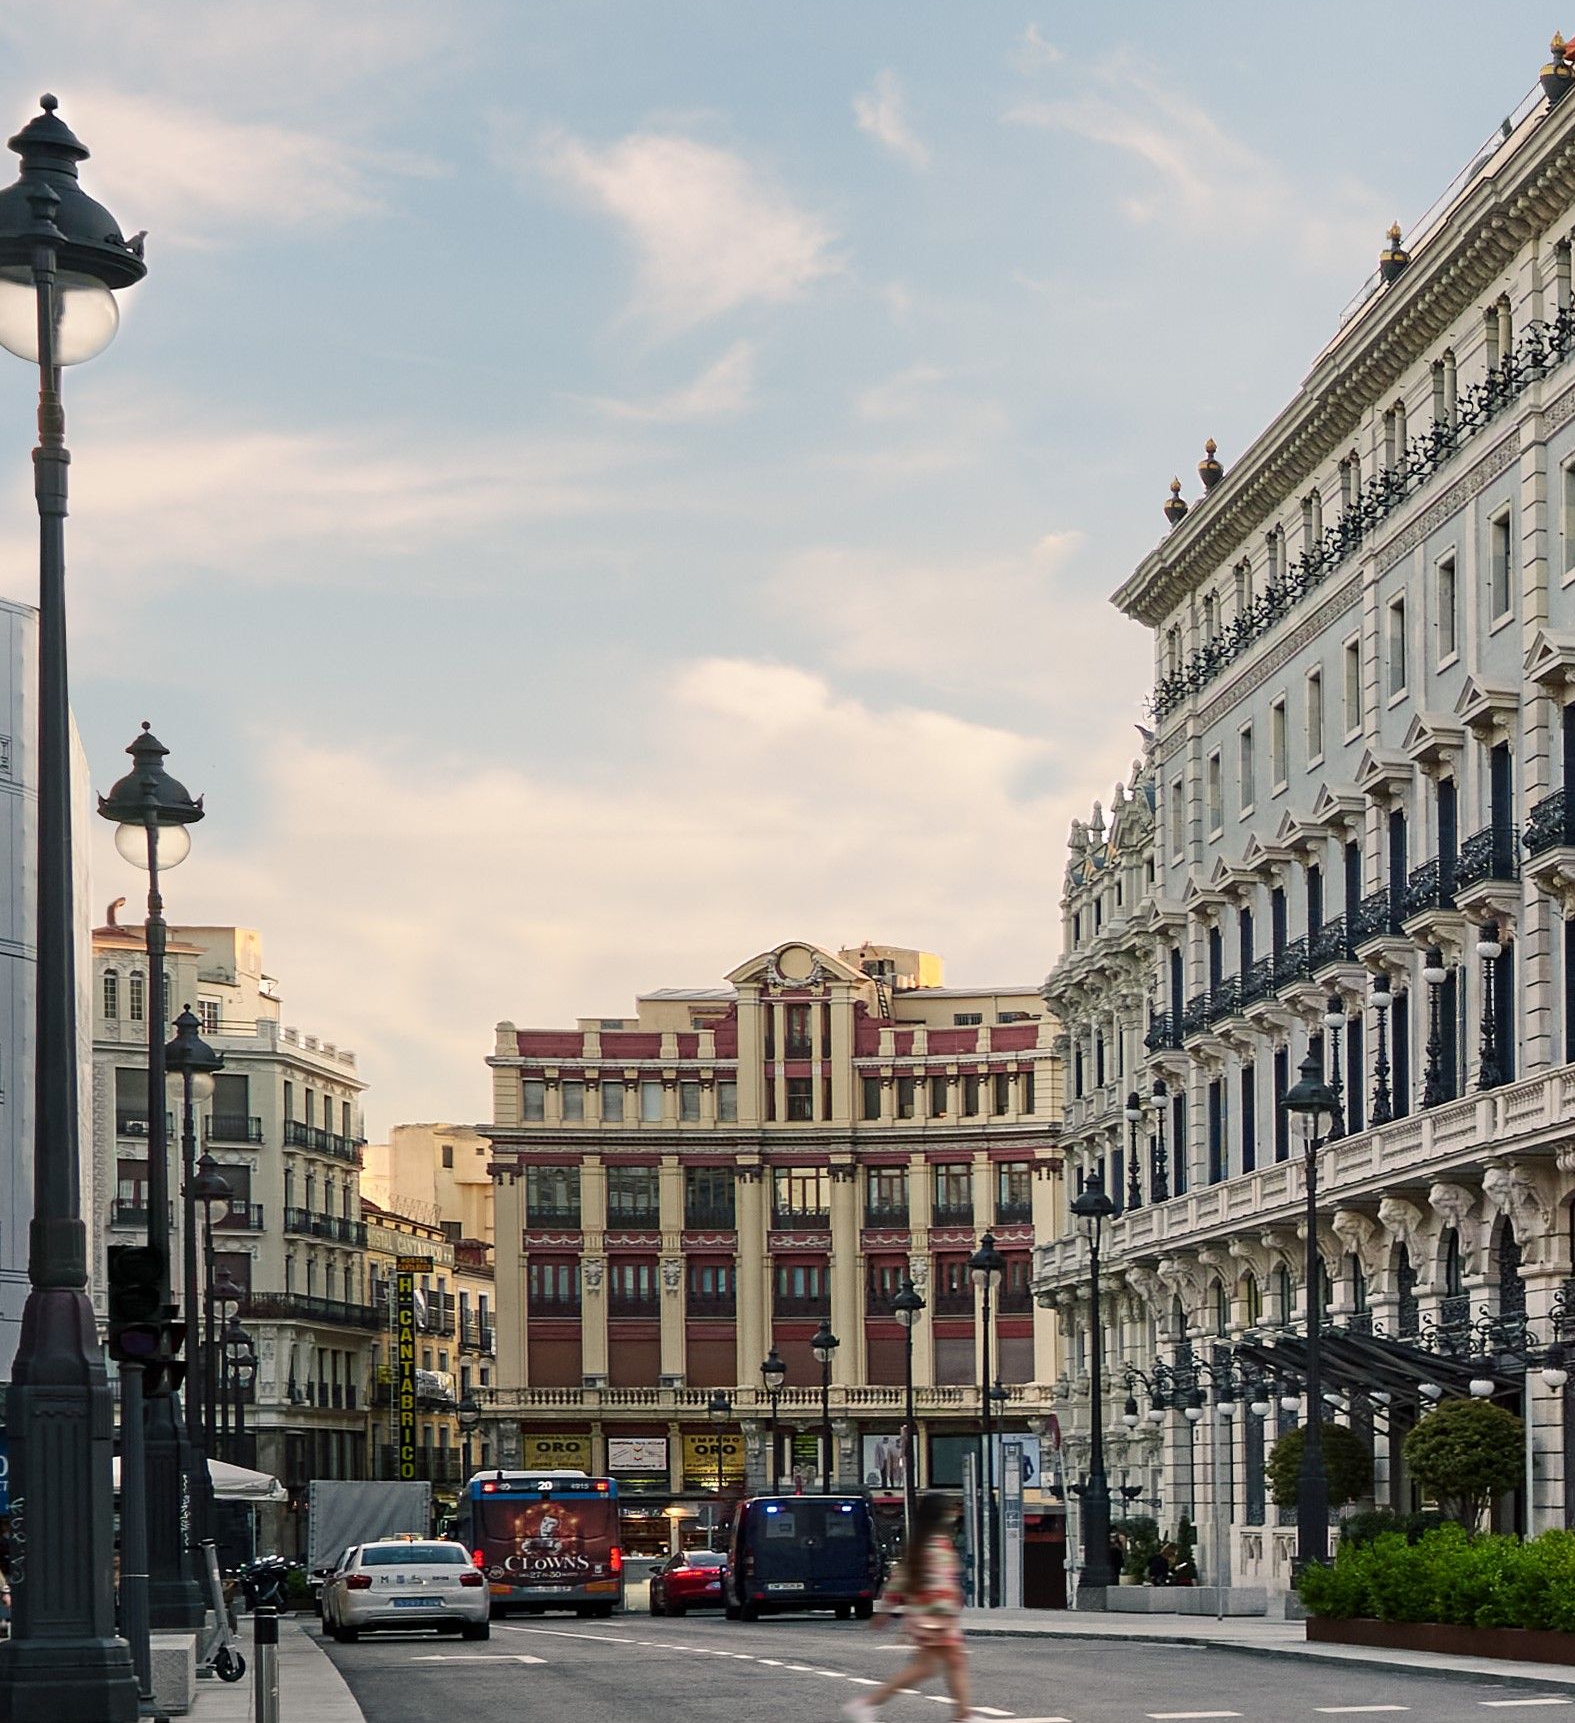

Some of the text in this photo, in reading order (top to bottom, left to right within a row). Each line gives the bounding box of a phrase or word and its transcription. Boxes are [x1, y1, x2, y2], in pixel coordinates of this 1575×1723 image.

[400, 1310, 415, 1478] CANTABRICO
[536, 1442, 580, 1452] ORO
[694, 1445, 736, 1454] ORO
[538, 1481, 553, 1491] 20
[504, 1555, 589, 1571] CLOWNS
